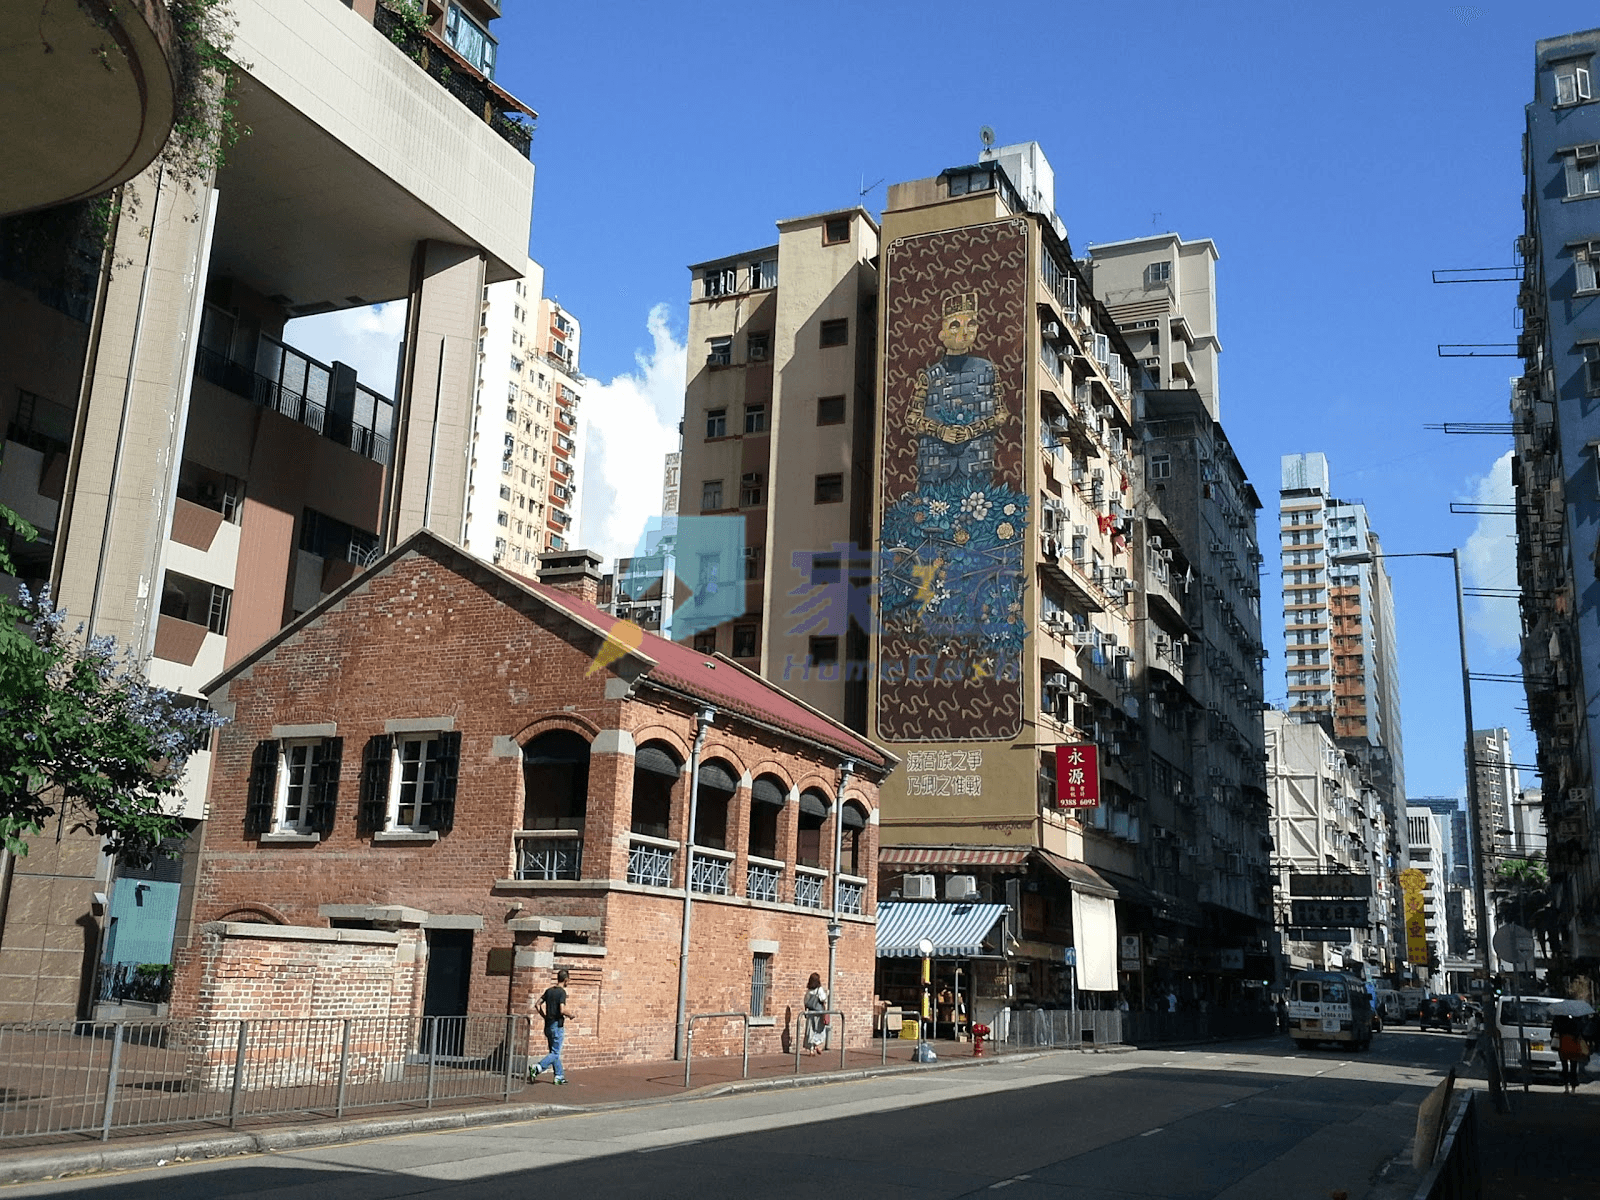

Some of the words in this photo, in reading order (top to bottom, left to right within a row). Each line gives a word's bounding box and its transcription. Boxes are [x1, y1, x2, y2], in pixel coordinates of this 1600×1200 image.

[1067, 747, 1086, 786] 永源
[1060, 798, 1077, 806] 9388
[1079, 798, 1096, 806] 6092
